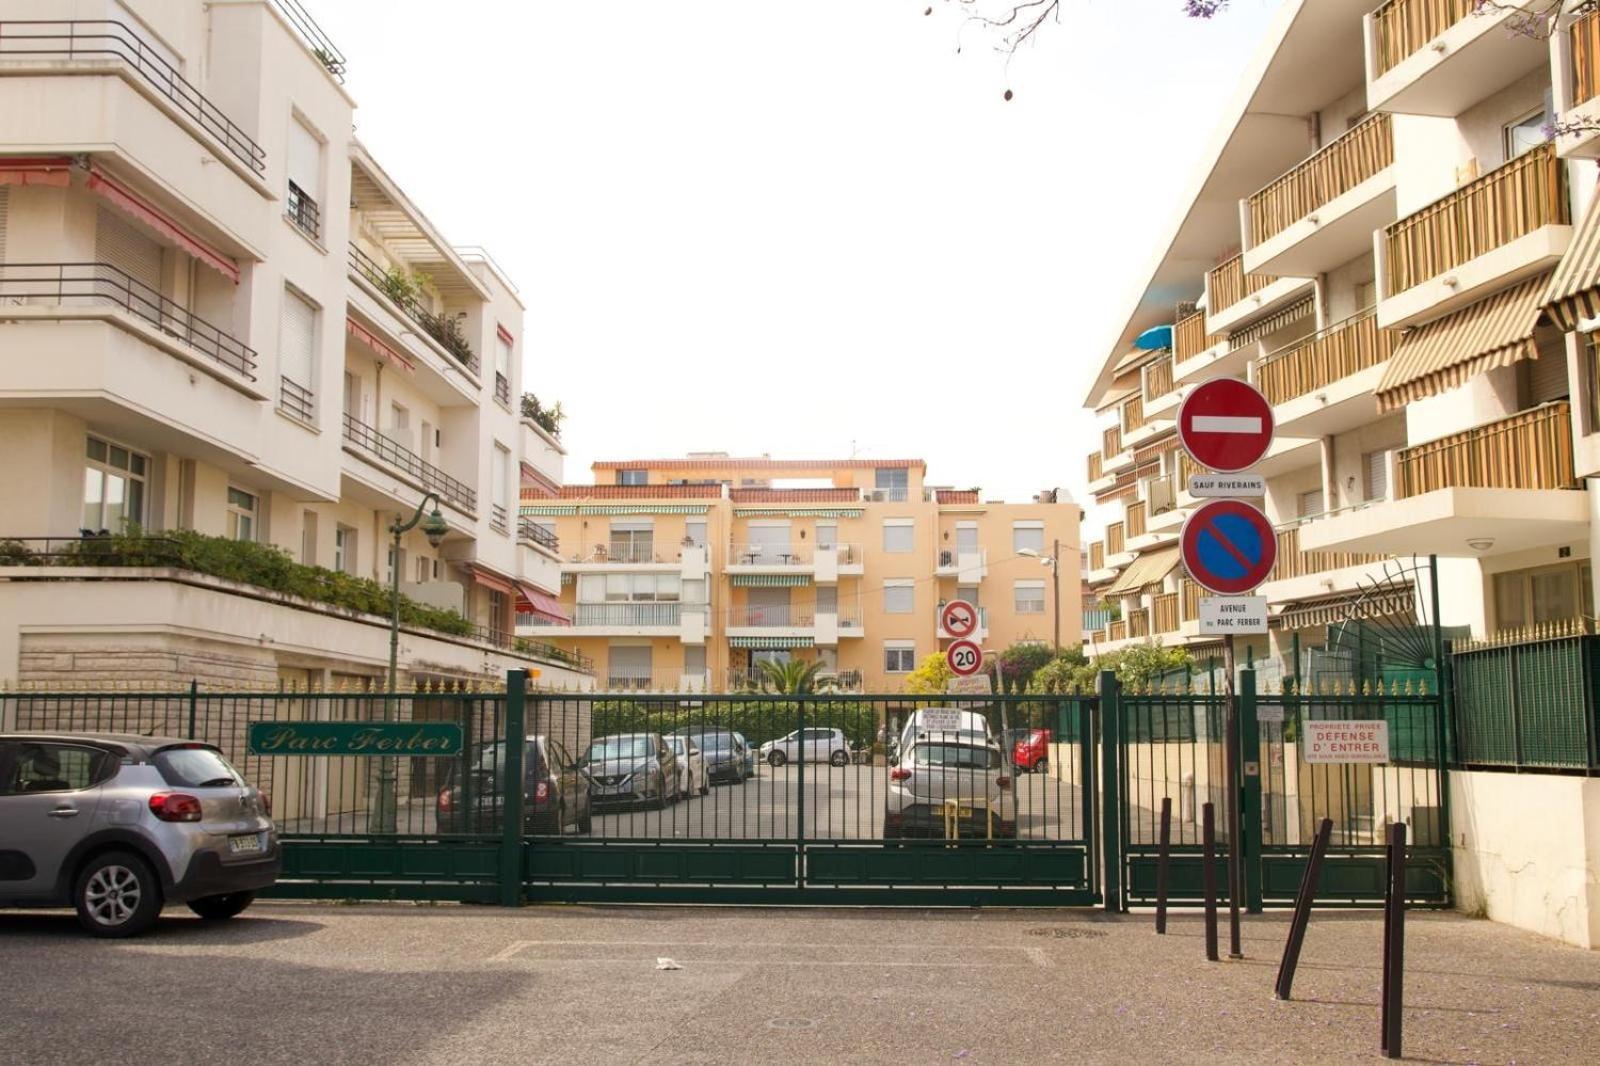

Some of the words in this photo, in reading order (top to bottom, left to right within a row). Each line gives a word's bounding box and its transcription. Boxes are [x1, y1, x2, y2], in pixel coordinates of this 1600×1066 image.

[1194, 481, 1214, 489] SAUF
[1218, 481, 1262, 489] RIVERAINS
[1220, 604, 1246, 613] AVENUE
[1217, 618, 1234, 626] PARC
[1237, 618, 1260, 626] FERBER
[956, 650, 976, 666] 20
[261, 725, 338, 750] Parc
[347, 727, 450, 751] Ferber
[1316, 732, 1375, 741] DEFENSE
